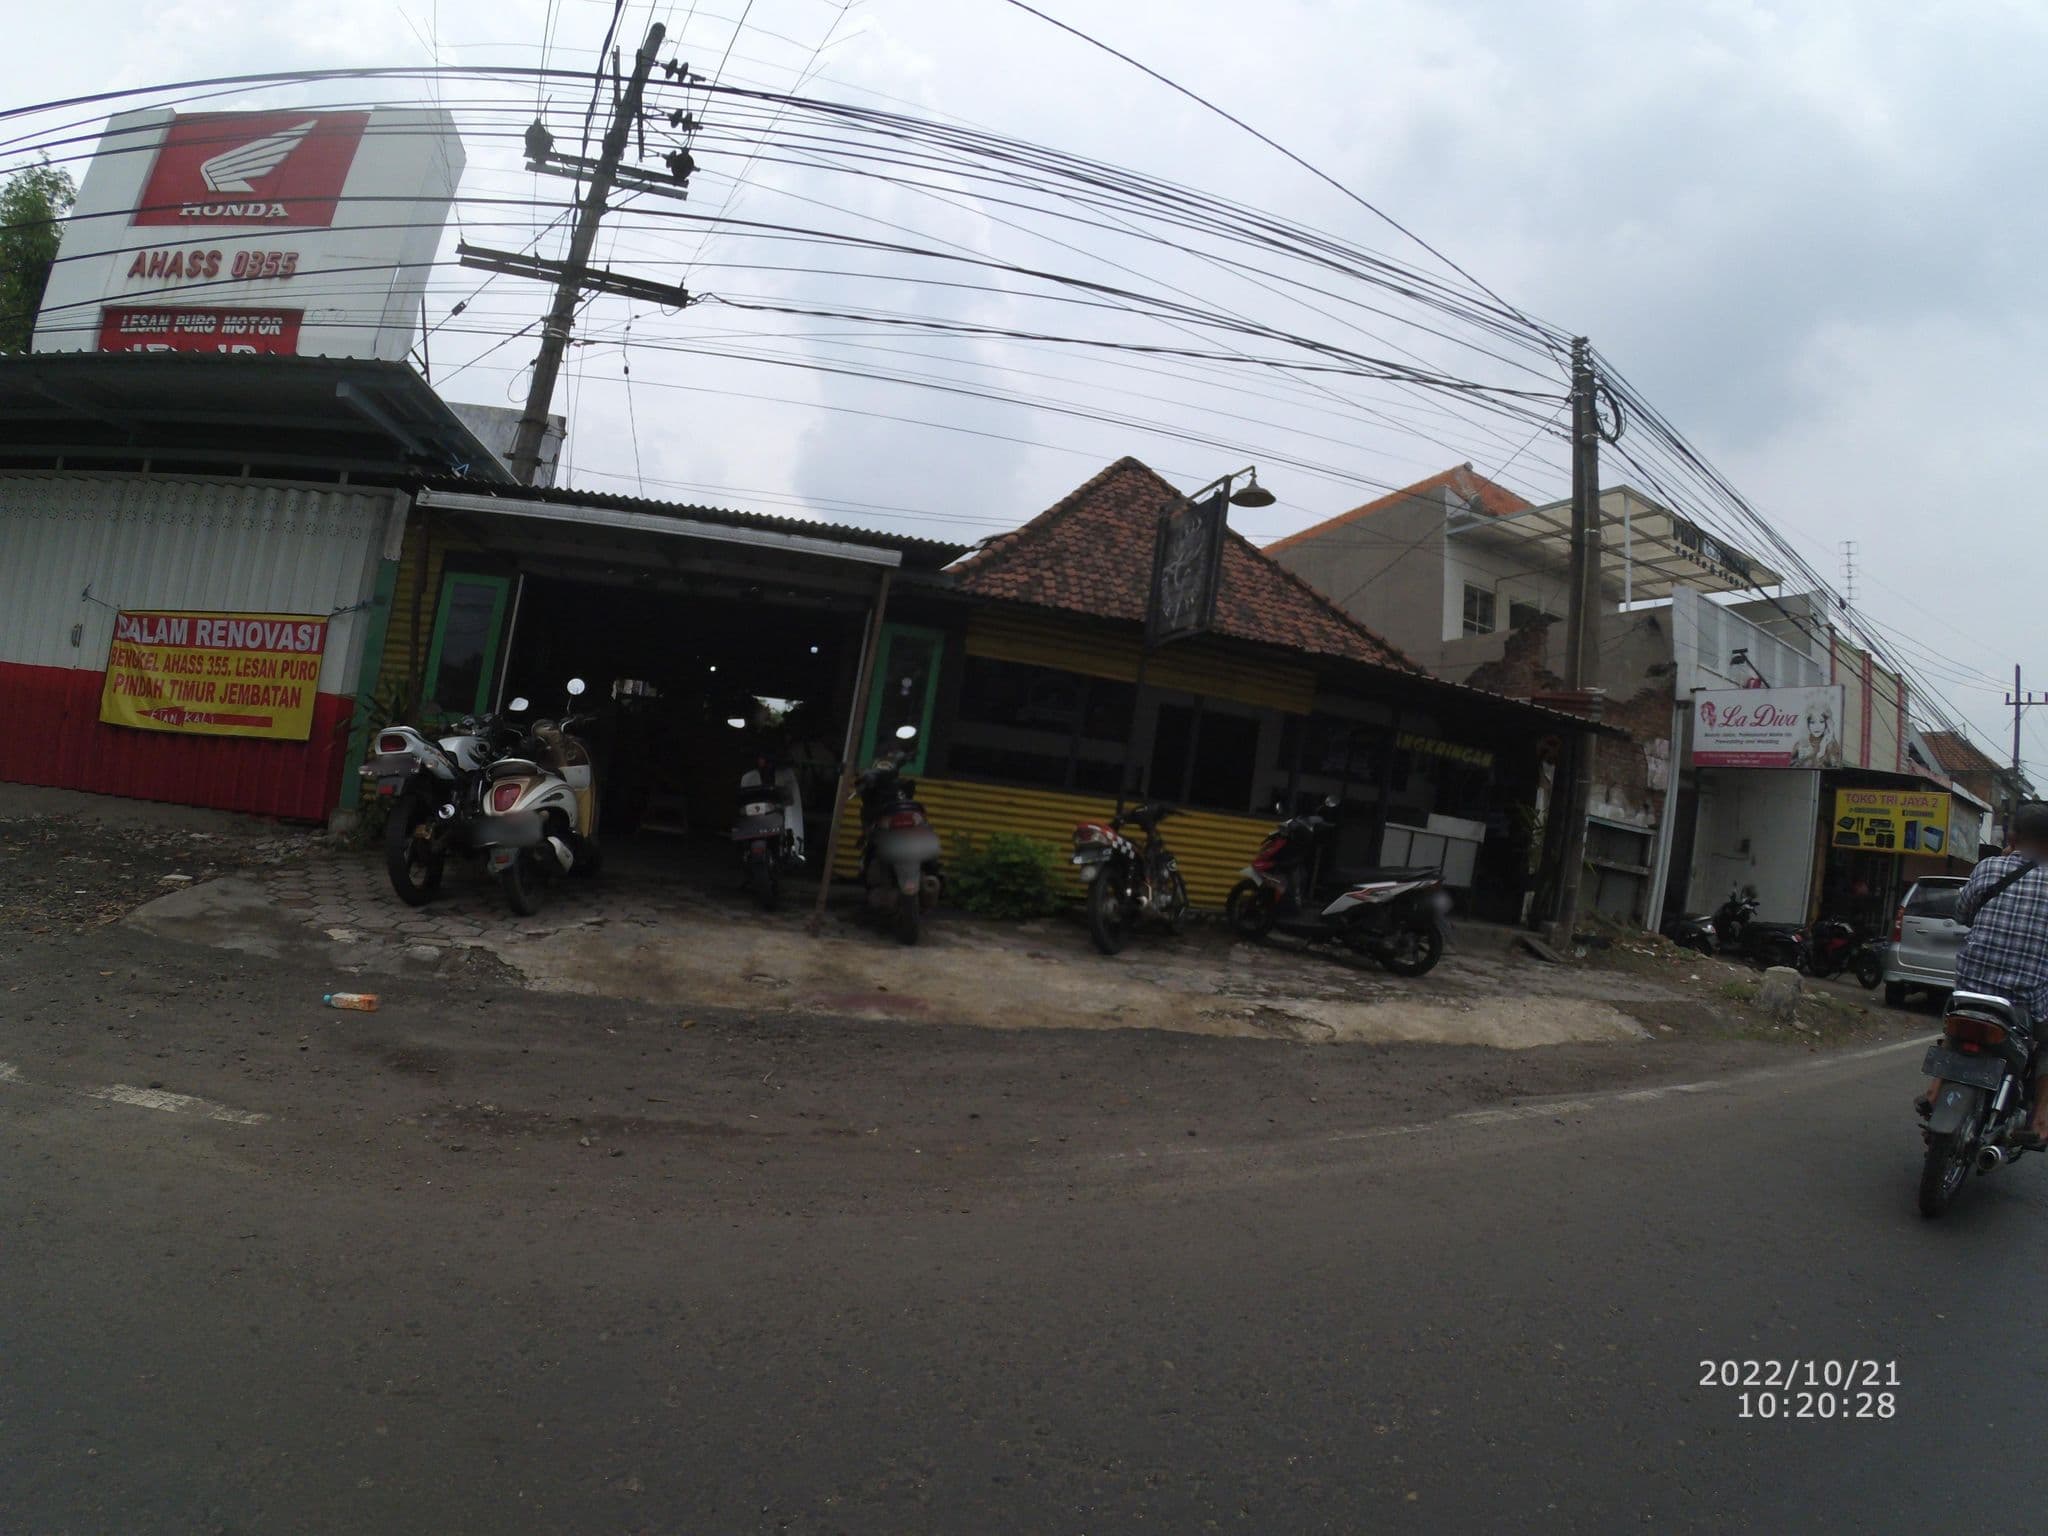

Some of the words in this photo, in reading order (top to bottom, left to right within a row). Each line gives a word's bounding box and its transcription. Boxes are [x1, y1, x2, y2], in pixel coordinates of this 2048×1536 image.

[179, 202, 288, 217] HONDA
[127, 250, 222, 279] AHASS
[231, 250, 299, 279] 0355
[120, 314, 170, 333] LESAN
[174, 314, 217, 334] PURO
[221, 316, 283, 335] MOTOR
[117, 614, 189, 645] DALAM
[195, 619, 321, 652] RENOVASI
[111, 646, 160, 671] BENGKEL
[163, 654, 203, 675] AHASS
[235, 657, 276, 678] LESAN
[280, 659, 318, 681] PURO
[113, 672, 164, 699] PINDAH
[169, 678, 216, 704] TIMUR
[219, 682, 302, 709] JEMBATAN
[1718, 704, 1748, 727] La
[1750, 704, 1800, 727] Diva
[1846, 793, 1876, 805] TOKO
[1879, 794, 1897, 806] TRI
[1900, 796, 1929, 807] JAYA
